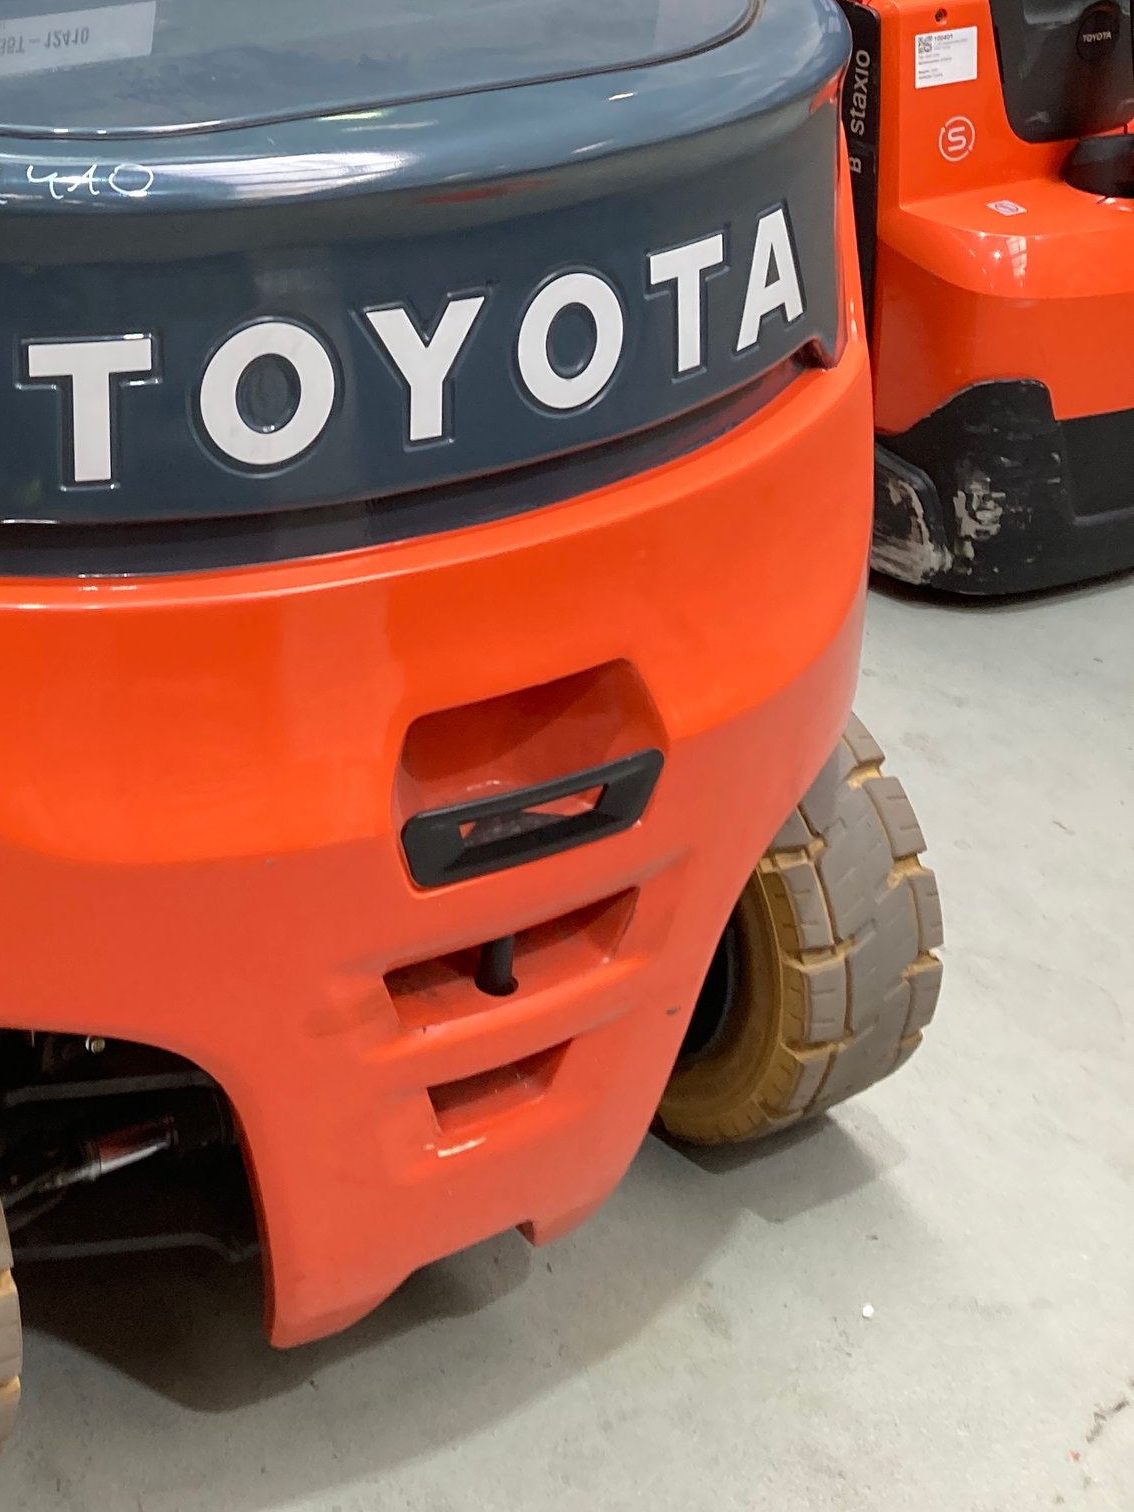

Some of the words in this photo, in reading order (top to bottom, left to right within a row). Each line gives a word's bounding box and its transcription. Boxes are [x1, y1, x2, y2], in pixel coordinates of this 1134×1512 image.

[1082, 29, 1113, 43] TOYOTA
[849, 49, 871, 137] staxio
[27, 204, 803, 484] TOYOTA
